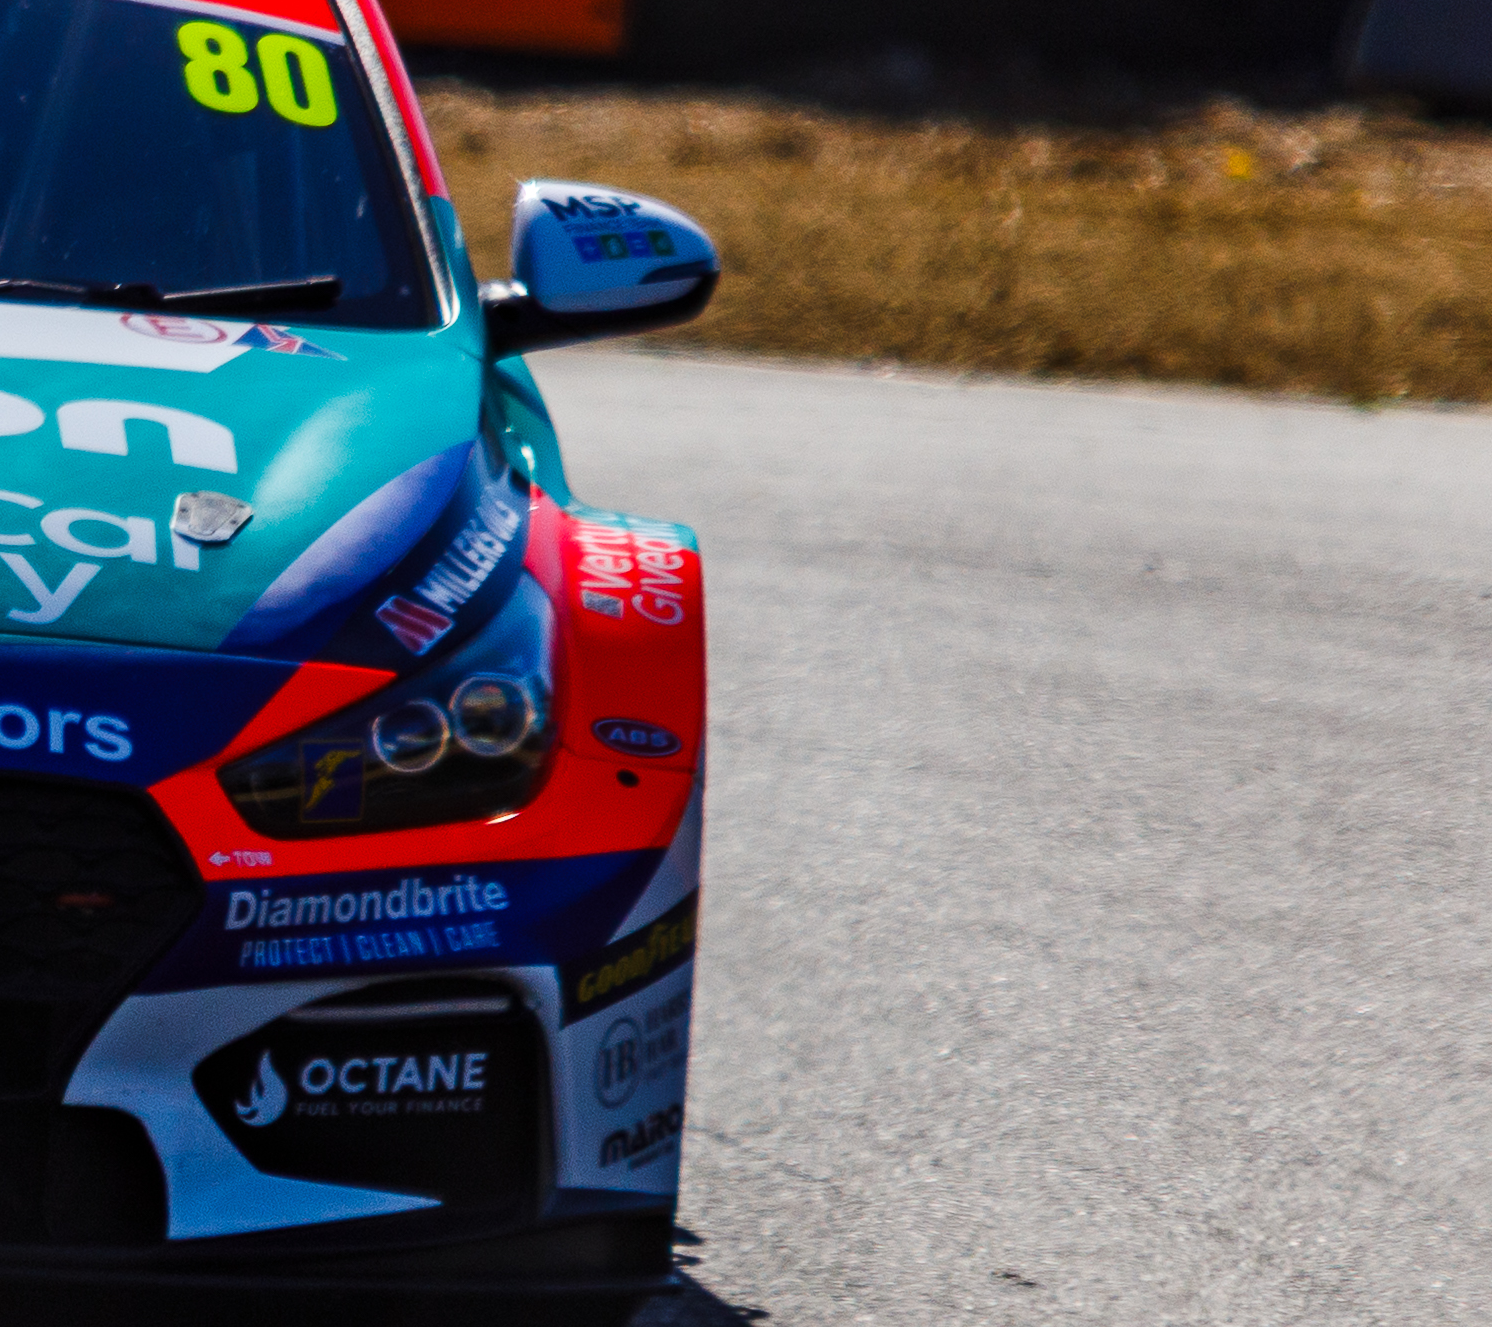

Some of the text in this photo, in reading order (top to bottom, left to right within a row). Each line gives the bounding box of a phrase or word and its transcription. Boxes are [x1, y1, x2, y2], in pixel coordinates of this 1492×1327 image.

[177, 20, 338, 127] 80
[224, 875, 510, 930] Diamondbrite
[240, 936, 334, 968] PROTECT
[354, 928, 425, 961] CLEAN
[300, 1053, 488, 1095] OCTANE
[295, 1097, 484, 1117] FUEL YOUR FINANCE
